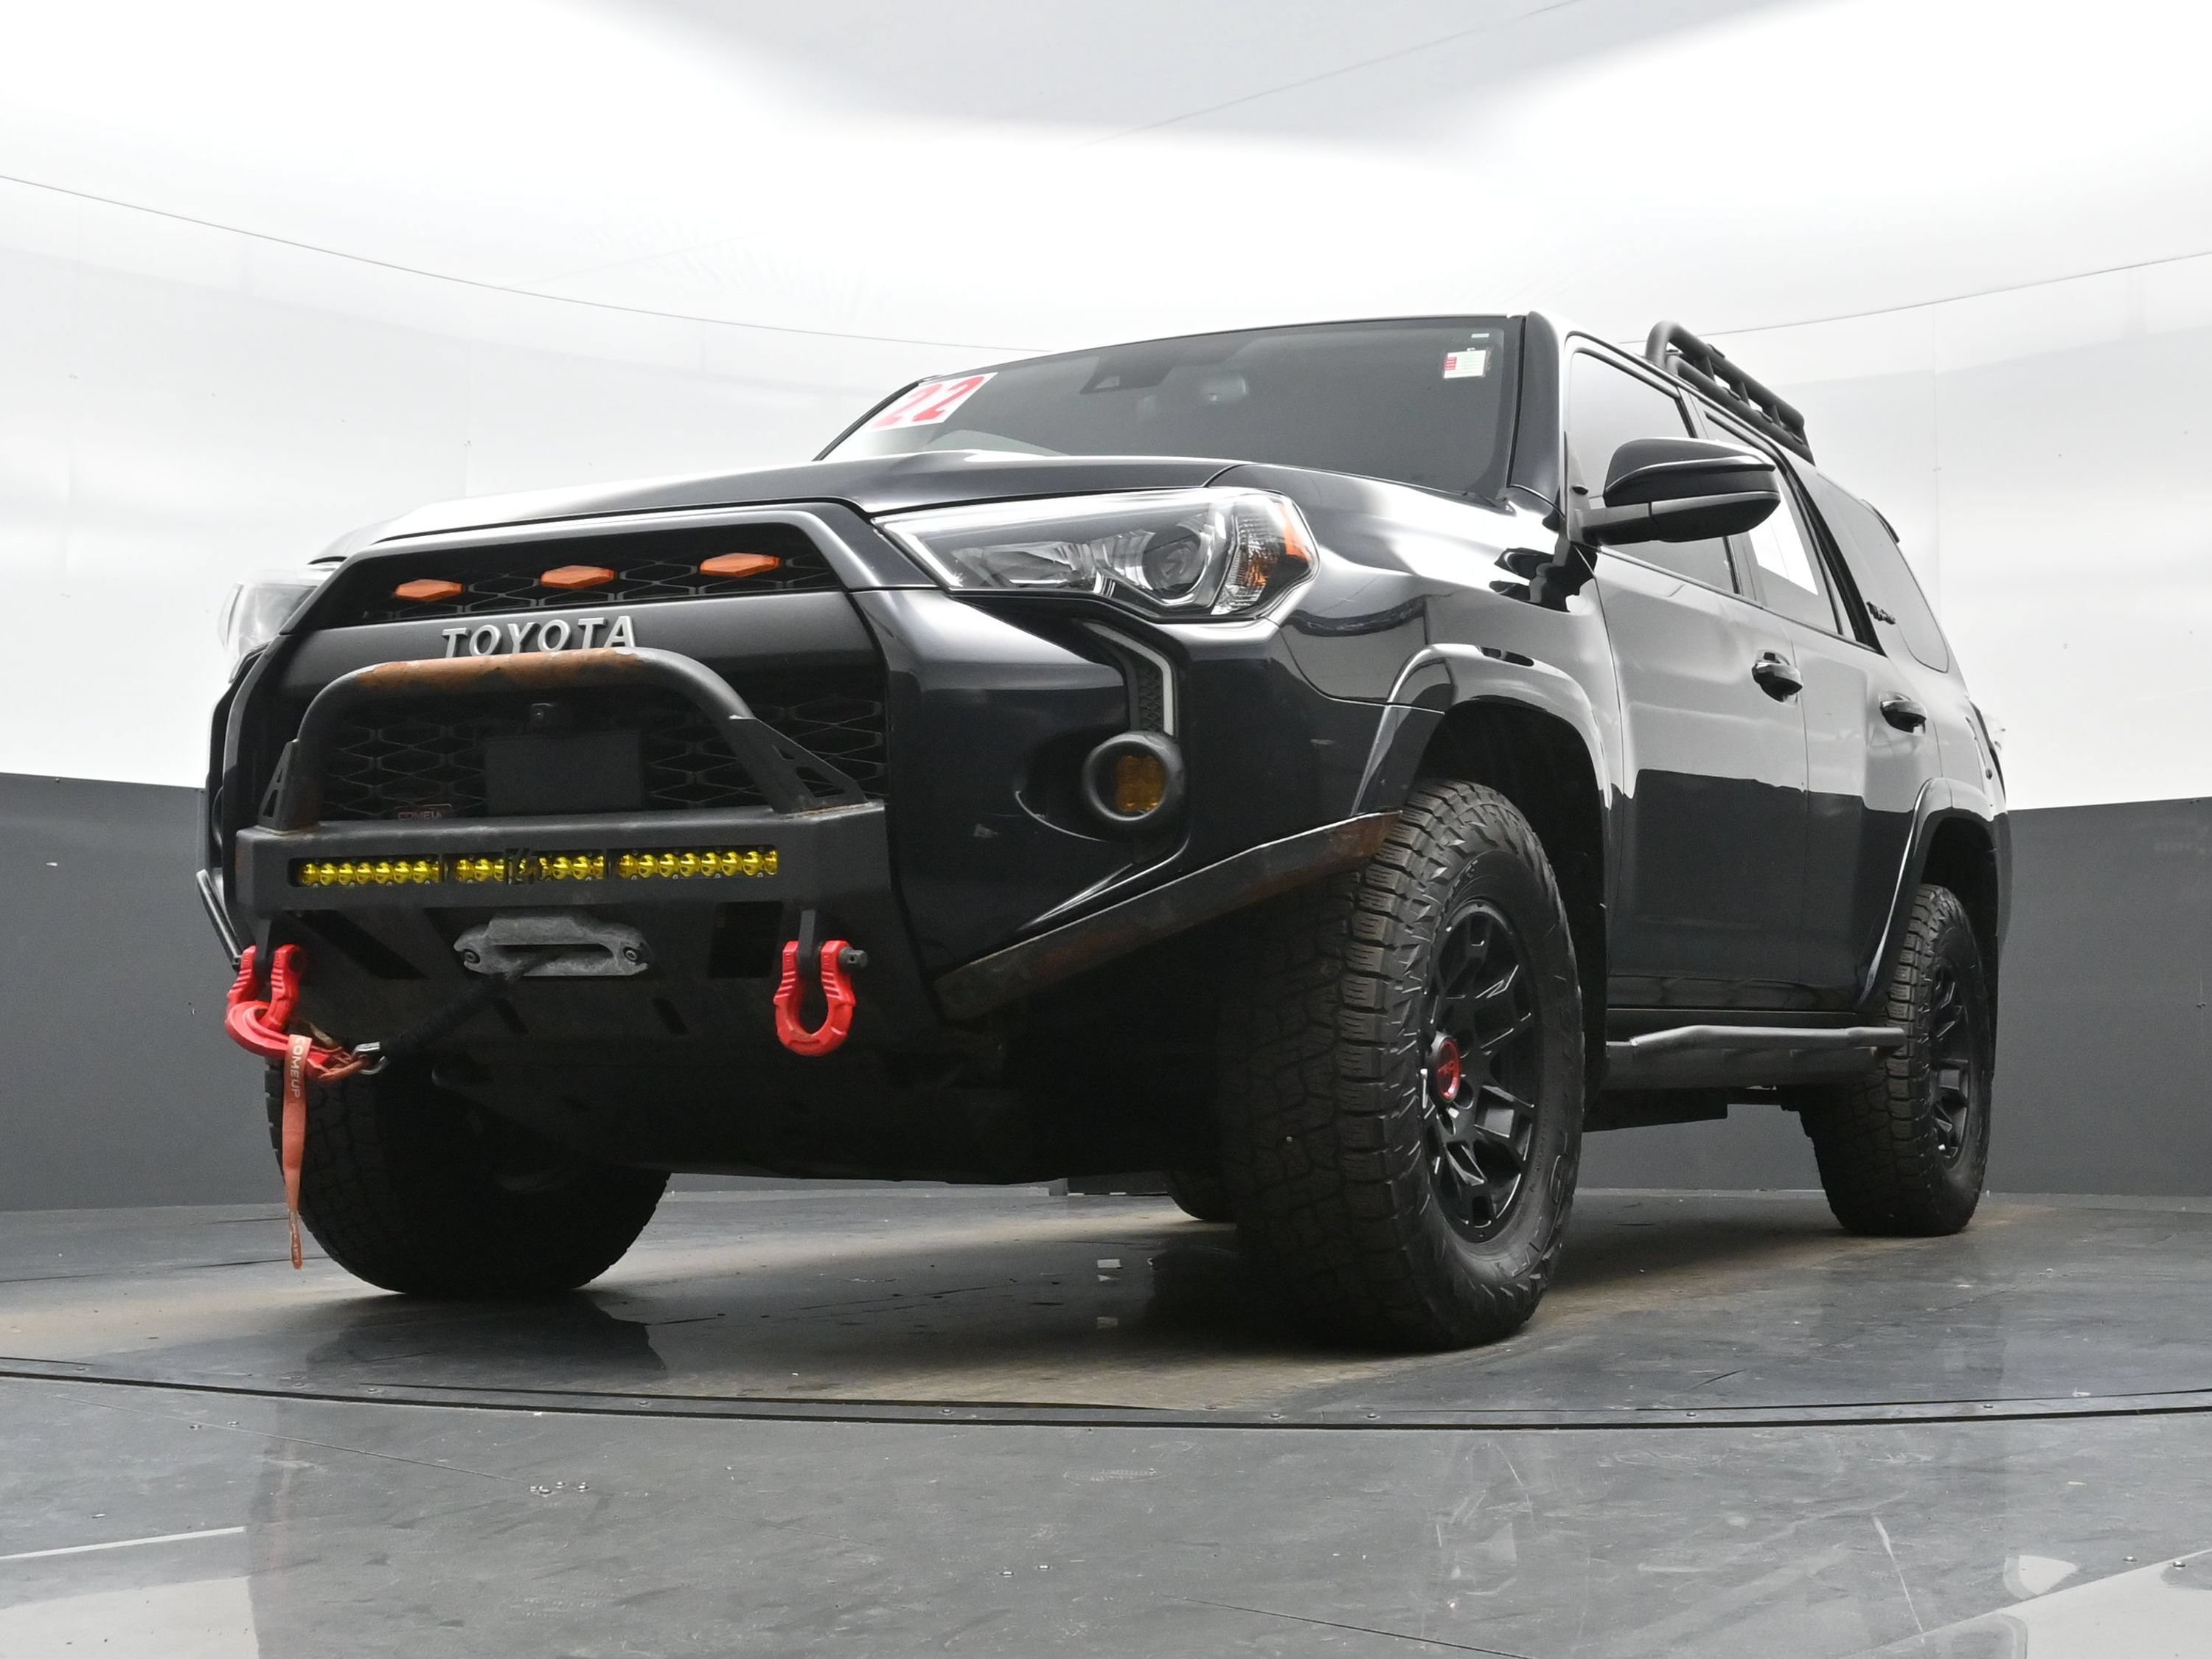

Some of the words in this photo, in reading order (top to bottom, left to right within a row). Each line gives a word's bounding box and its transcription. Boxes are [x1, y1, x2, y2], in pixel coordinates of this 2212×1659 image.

[871, 376, 985, 429] 22
[442, 615, 636, 658] TOYOTA
[290, 1037, 306, 1098] COMEUP
